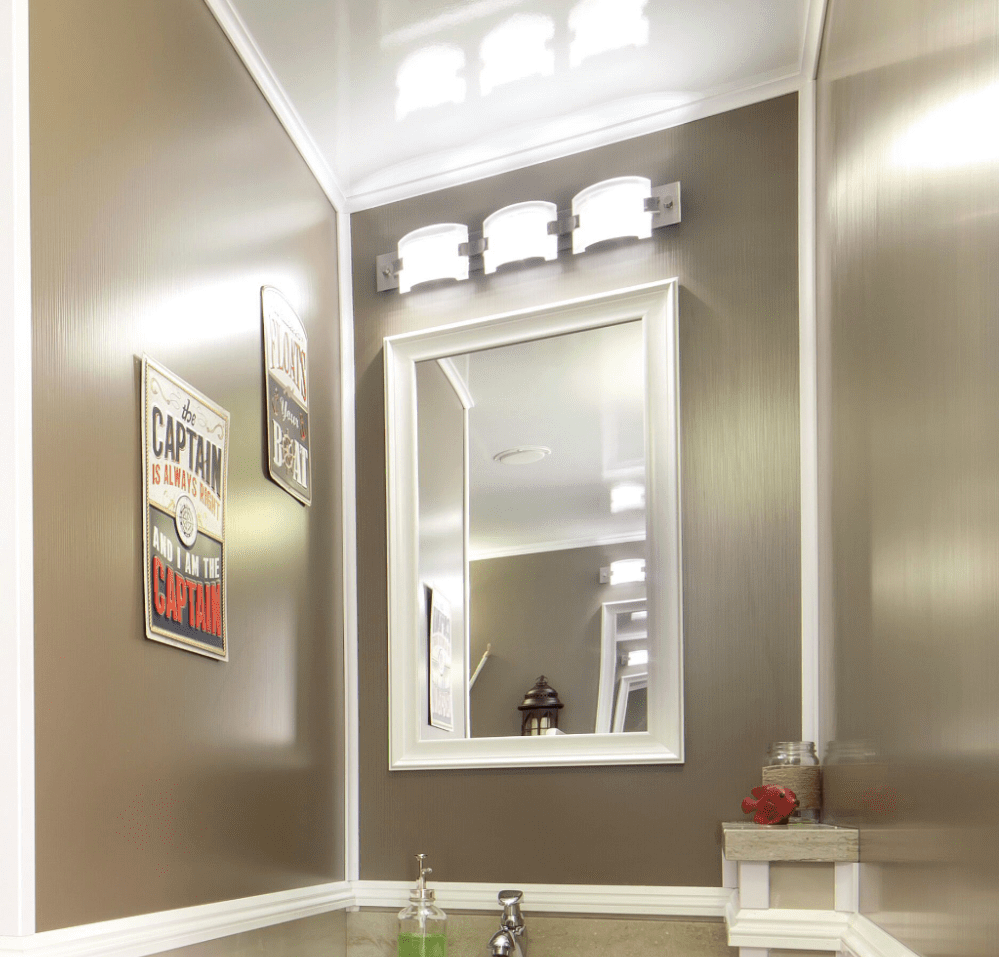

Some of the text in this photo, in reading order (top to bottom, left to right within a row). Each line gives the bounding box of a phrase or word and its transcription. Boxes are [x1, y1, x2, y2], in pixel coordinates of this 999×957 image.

[268, 314, 307, 402] FLOATS
[182, 399, 196, 426] the
[280, 396, 299, 429] Your
[152, 405, 222, 500] CAPTAIN
[152, 463, 221, 521] IS ALWAYS RIGHT
[153, 525, 220, 579] AND I AM THE
[153, 555, 222, 638] CAPTAIN
